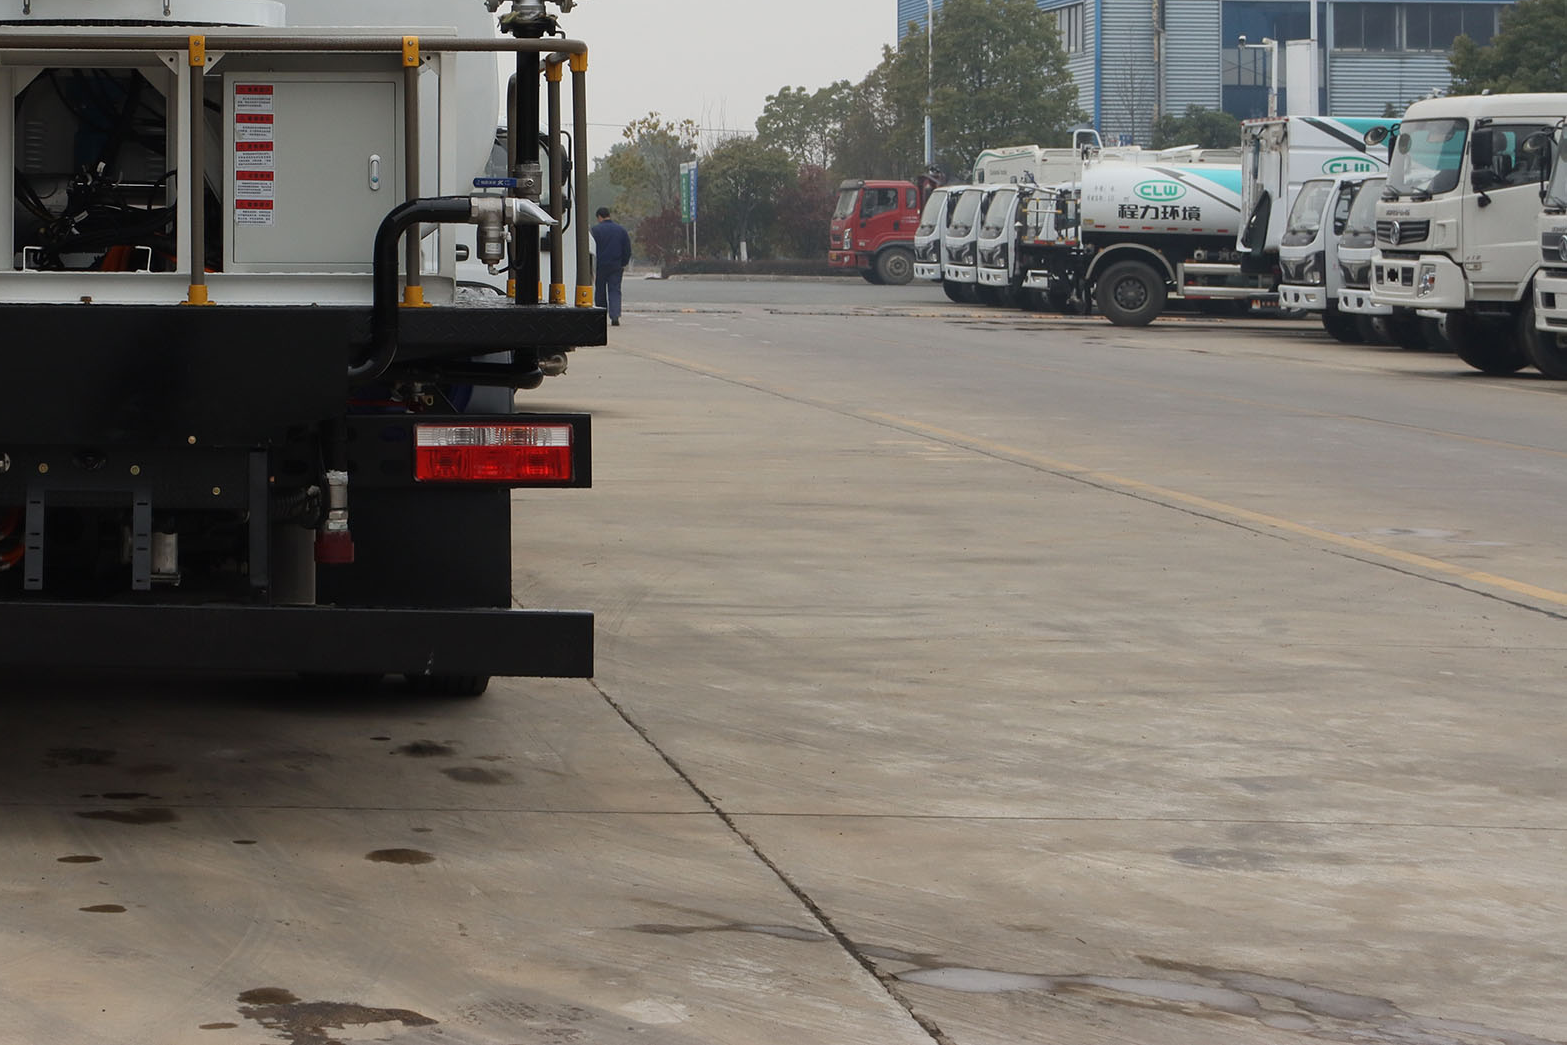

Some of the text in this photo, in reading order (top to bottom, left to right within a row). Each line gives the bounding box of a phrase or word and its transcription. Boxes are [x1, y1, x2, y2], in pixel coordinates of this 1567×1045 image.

[1140, 185, 1178, 196] CLW
[1118, 204, 1201, 221] 程力环境
